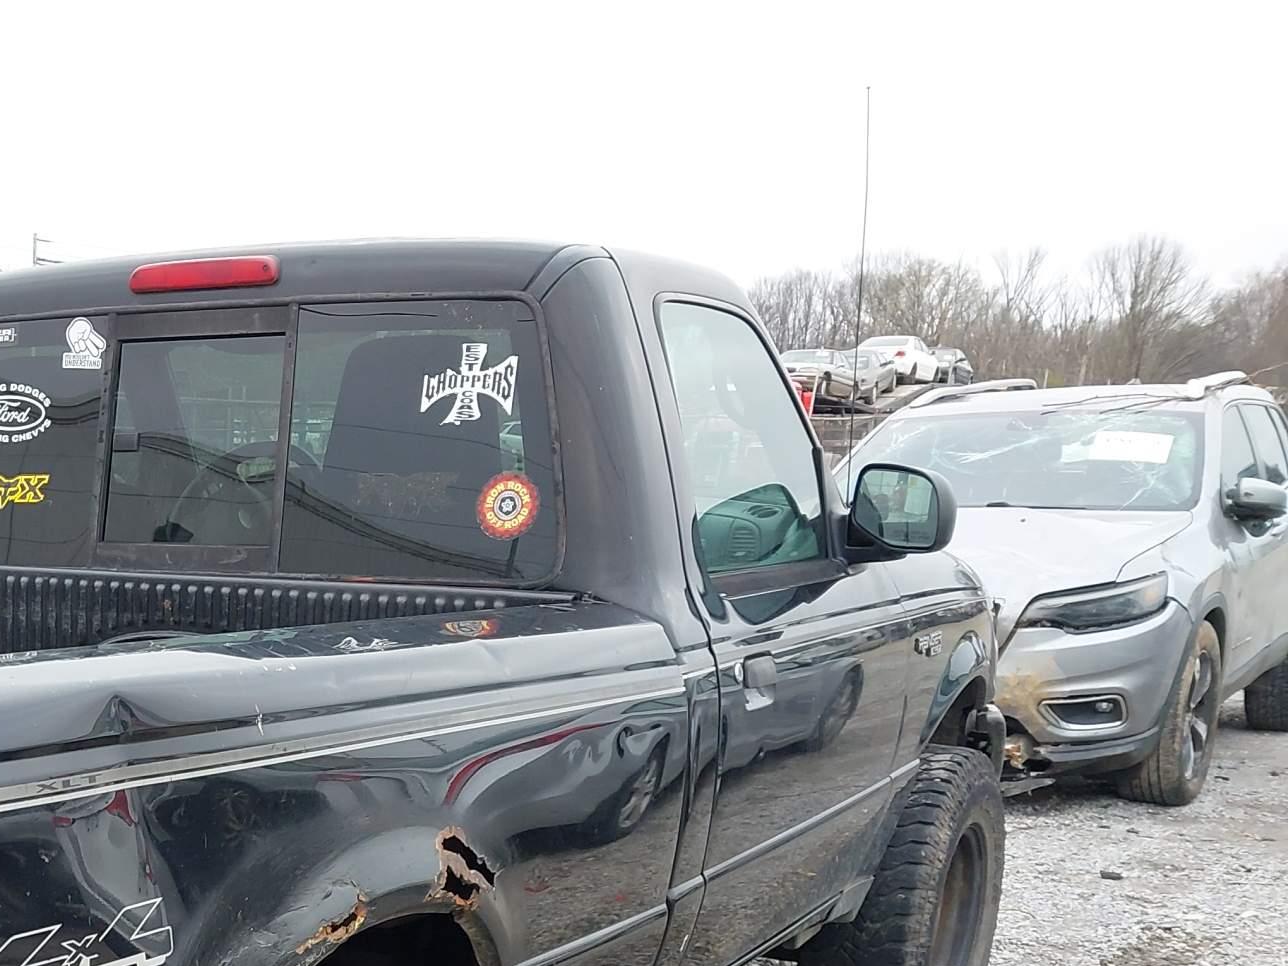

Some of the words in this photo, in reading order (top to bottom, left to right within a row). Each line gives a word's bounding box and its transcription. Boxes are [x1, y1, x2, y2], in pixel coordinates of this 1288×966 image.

[424, 361, 514, 402] CHOPPERS
[10, 383, 51, 407] DODGES
[11, 418, 51, 443] CHEVYS
[485, 482, 505, 508] IRON
[508, 481, 530, 504] ROCK
[37, 773, 102, 793] XLT
